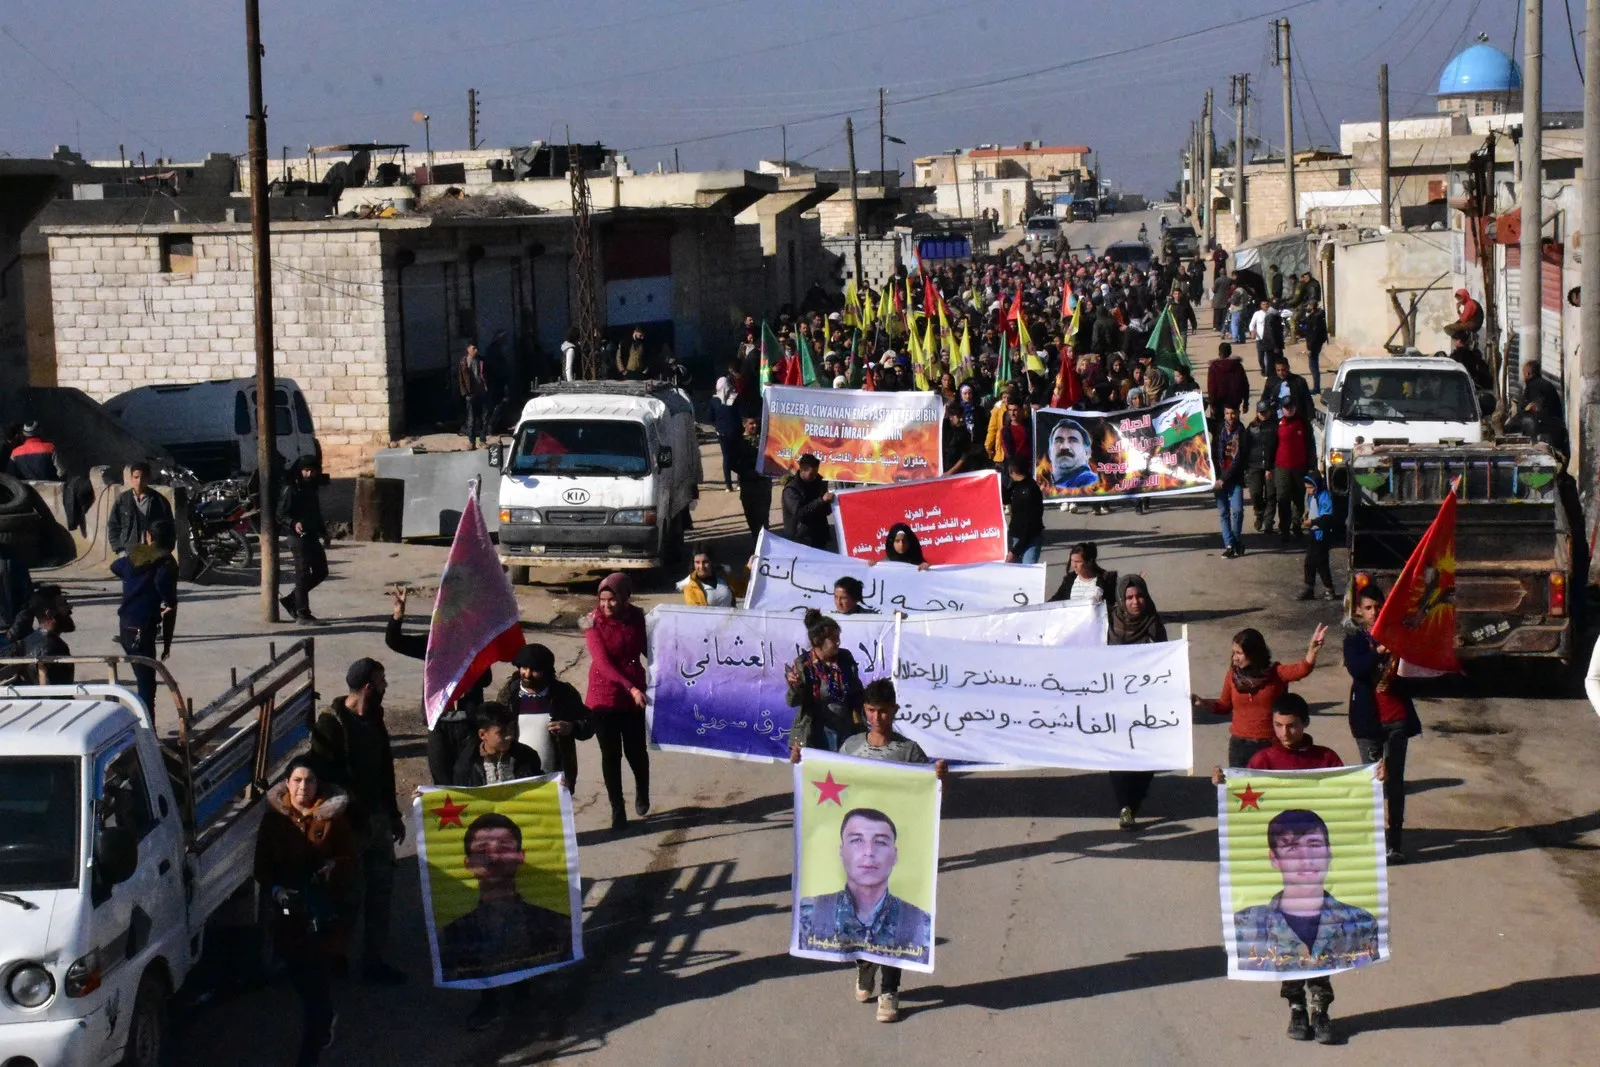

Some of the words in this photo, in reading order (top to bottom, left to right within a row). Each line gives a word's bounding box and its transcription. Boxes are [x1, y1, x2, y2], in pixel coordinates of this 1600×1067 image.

[780, 401, 810, 417] XEZEBA
[803, 423, 840, 439] PERGALA
[567, 492, 586, 501] KIA
[680, 635, 774, 685] العثماني
[1041, 671, 1115, 696] الشبيبة
[1124, 669, 1172, 695] بروح
[753, 709, 792, 741] رق
[1028, 705, 1117, 735] الفاشية
[1128, 703, 1180, 749] نحطم
